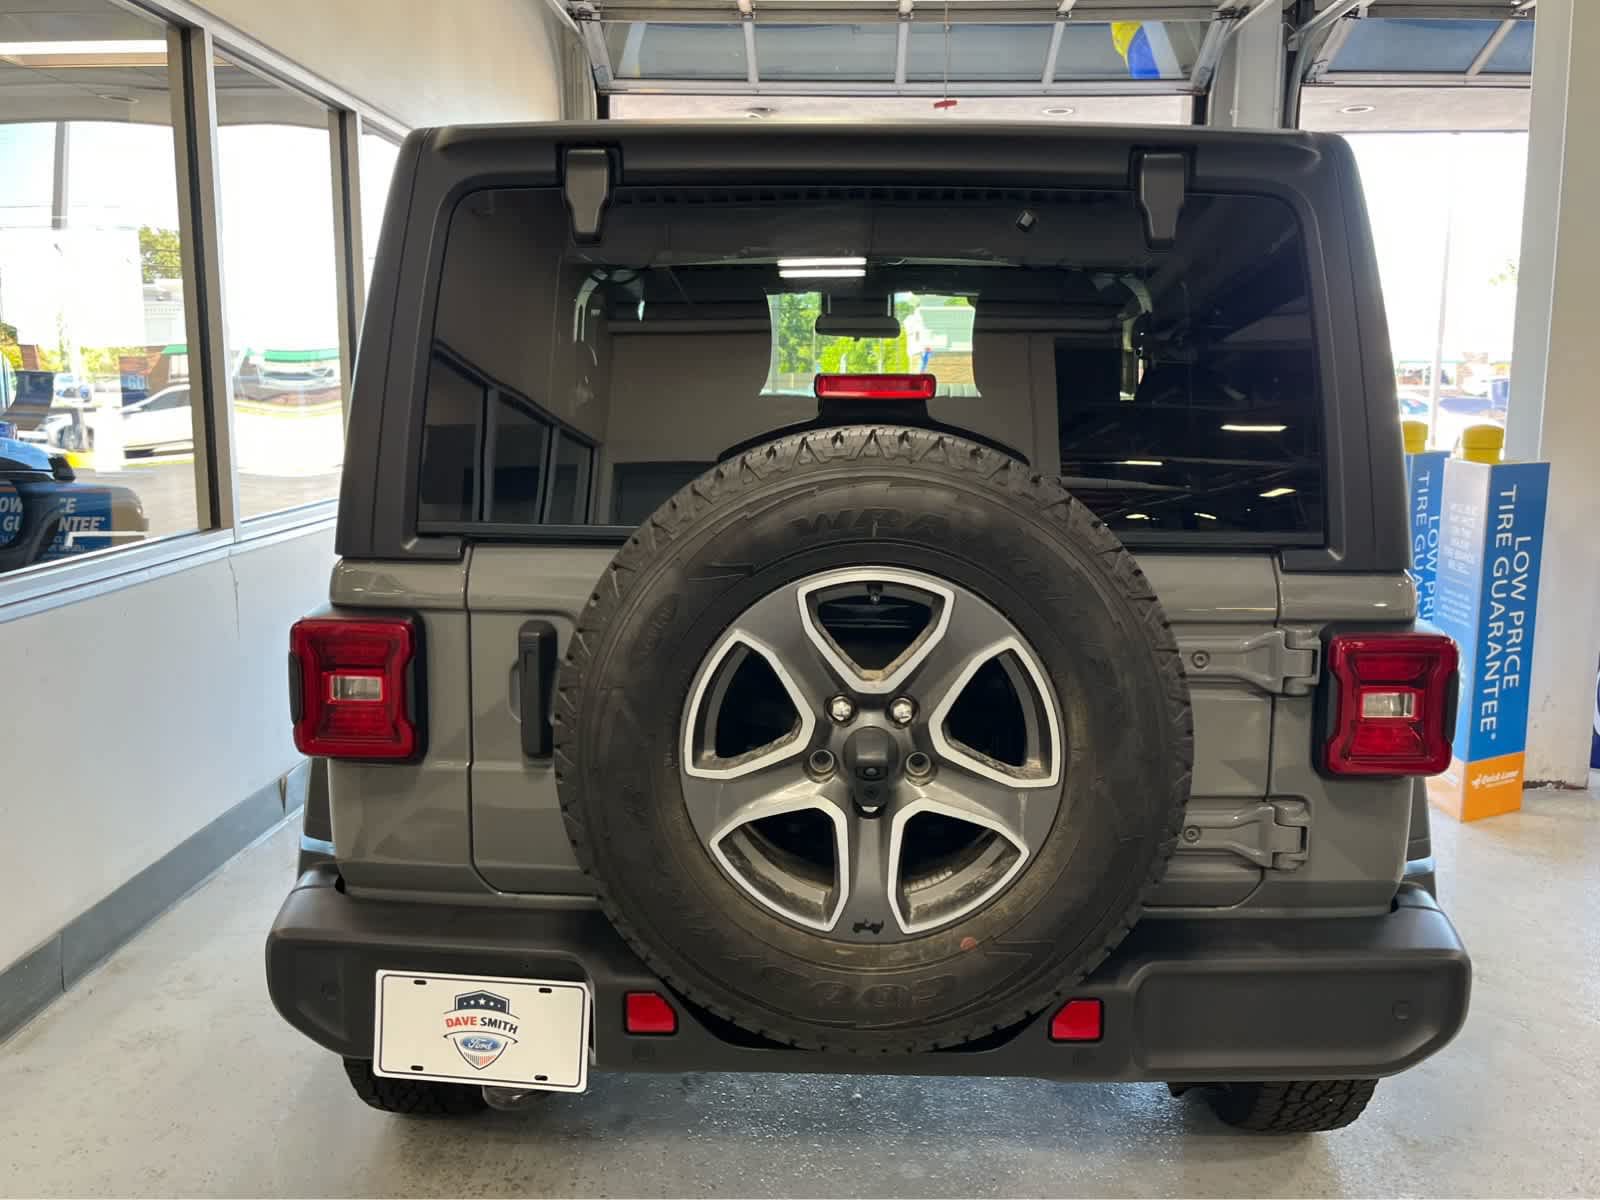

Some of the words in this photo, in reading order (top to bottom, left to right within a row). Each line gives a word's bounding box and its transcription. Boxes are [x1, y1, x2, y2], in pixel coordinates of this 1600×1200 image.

[0, 496, 23, 513] OW
[1416, 471, 1431, 528] TIRE
[1495, 484, 1518, 549] TIRE
[1510, 535, 1532, 601] LOW
[1502, 610, 1525, 690] PRICE
[445, 1016, 477, 1028] DAVE
[480, 1016, 518, 1035] SMITH
[467, 1039, 493, 1050] Ford
